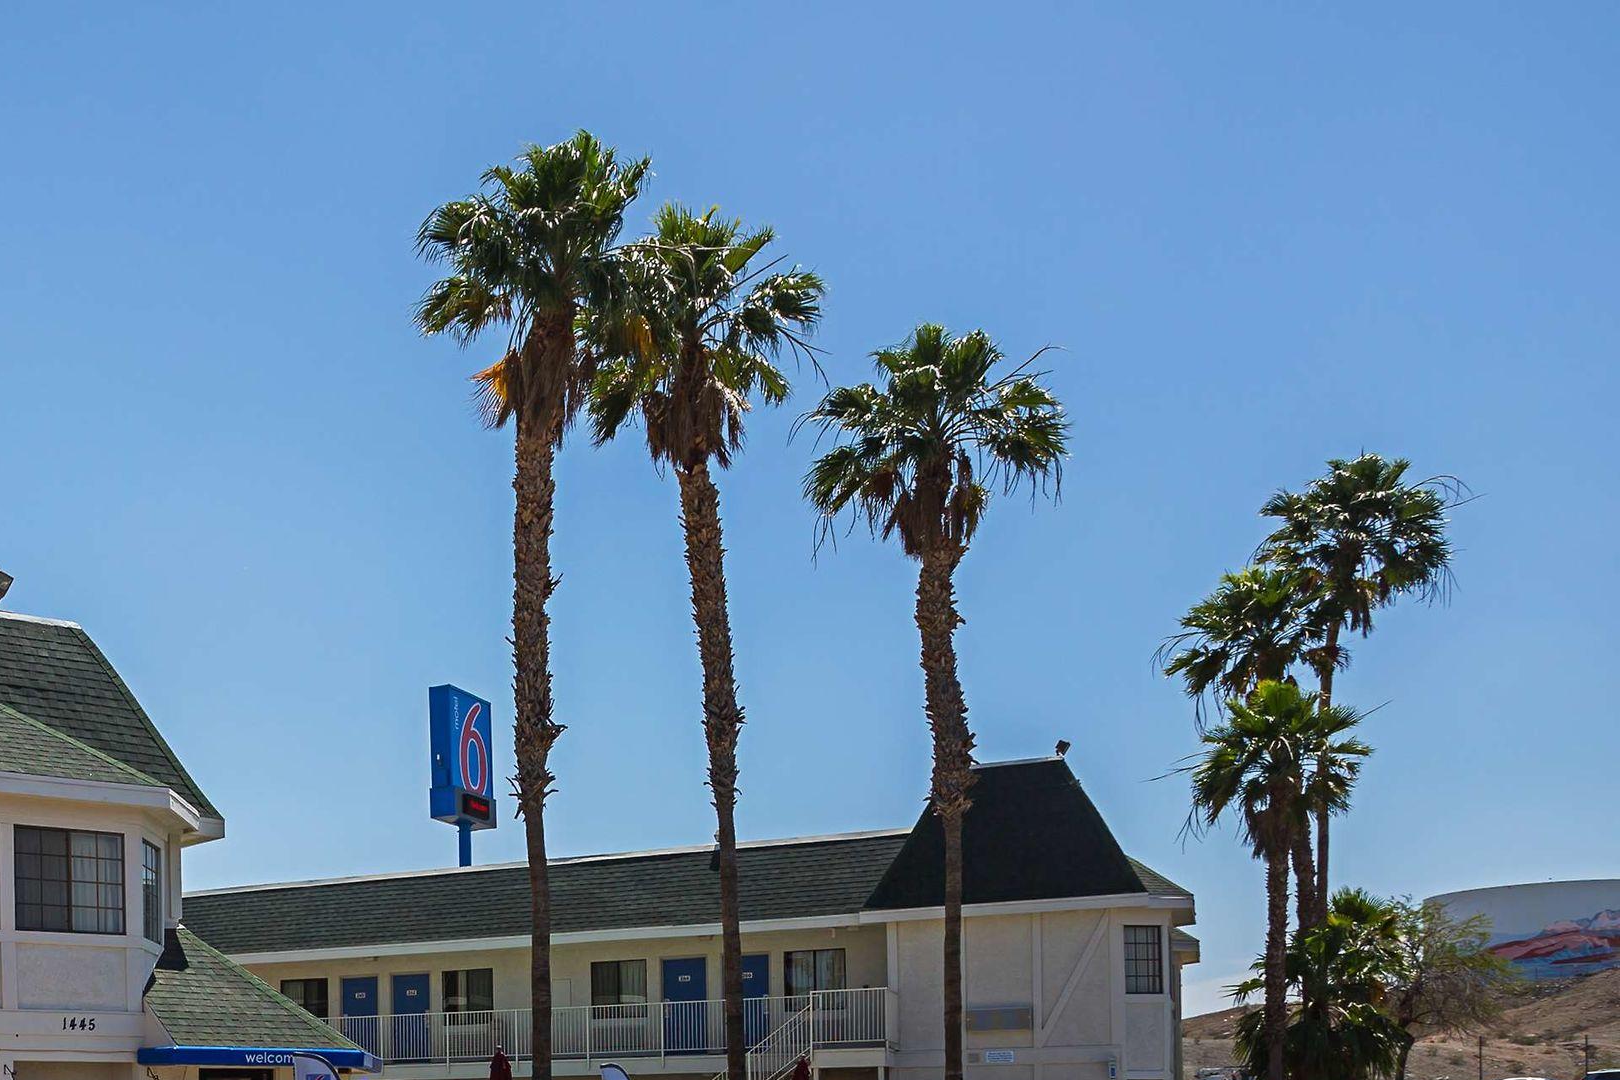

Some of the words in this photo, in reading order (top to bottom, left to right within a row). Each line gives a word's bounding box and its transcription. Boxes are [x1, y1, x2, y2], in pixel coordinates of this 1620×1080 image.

[452, 696, 460, 730] motel
[459, 702, 488, 796] 6
[63, 1017, 96, 1031] 1445
[245, 1052, 295, 1064] welcom
